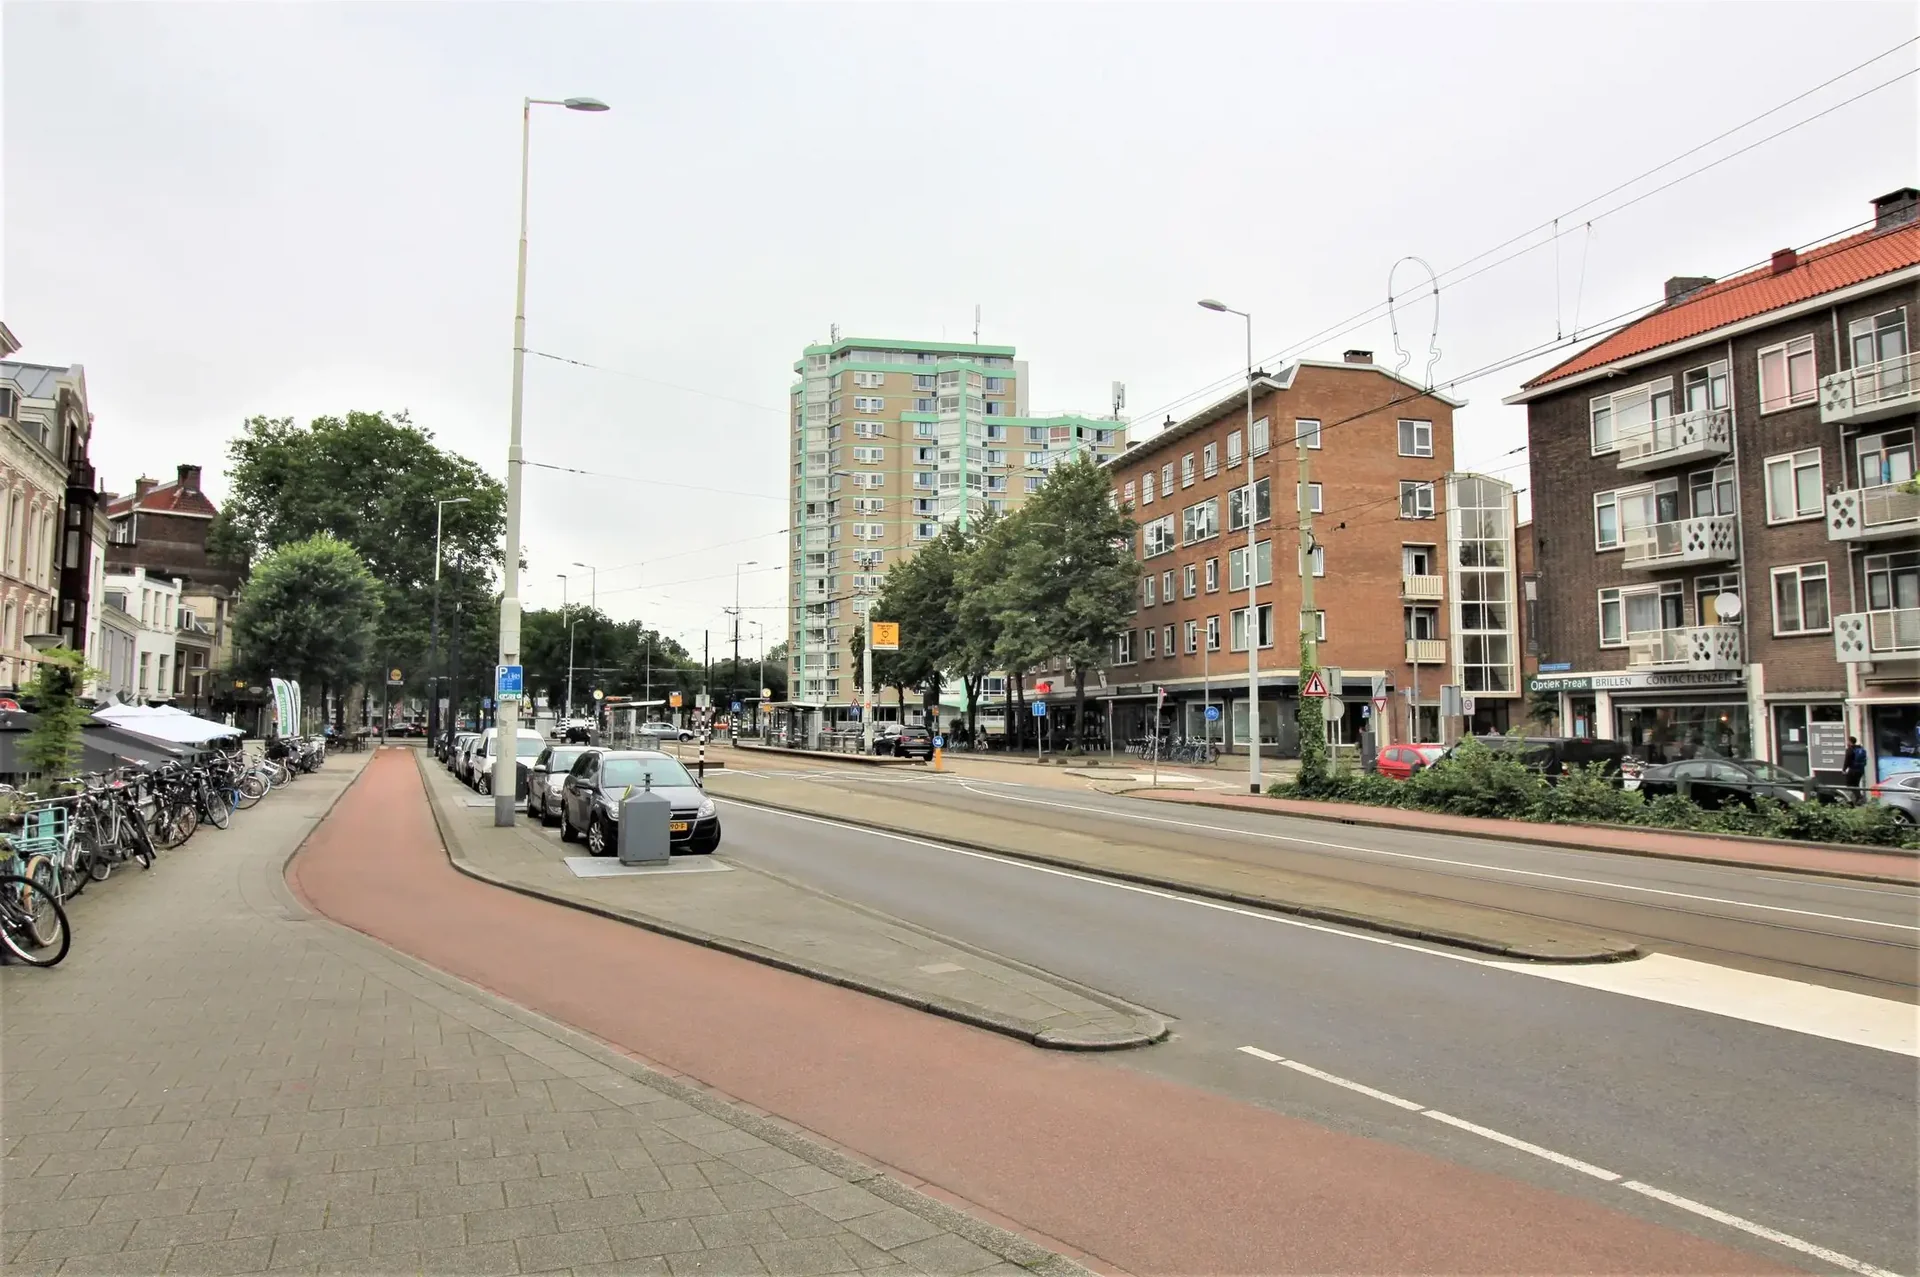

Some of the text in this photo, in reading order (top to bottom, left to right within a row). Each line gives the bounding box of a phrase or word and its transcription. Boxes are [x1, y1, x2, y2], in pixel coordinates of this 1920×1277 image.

[500, 667, 508, 679] P
[1530, 680, 1560, 691] Optiek
[1562, 679, 1588, 690] Freak
[1595, 678, 1632, 687] BRILLEN
